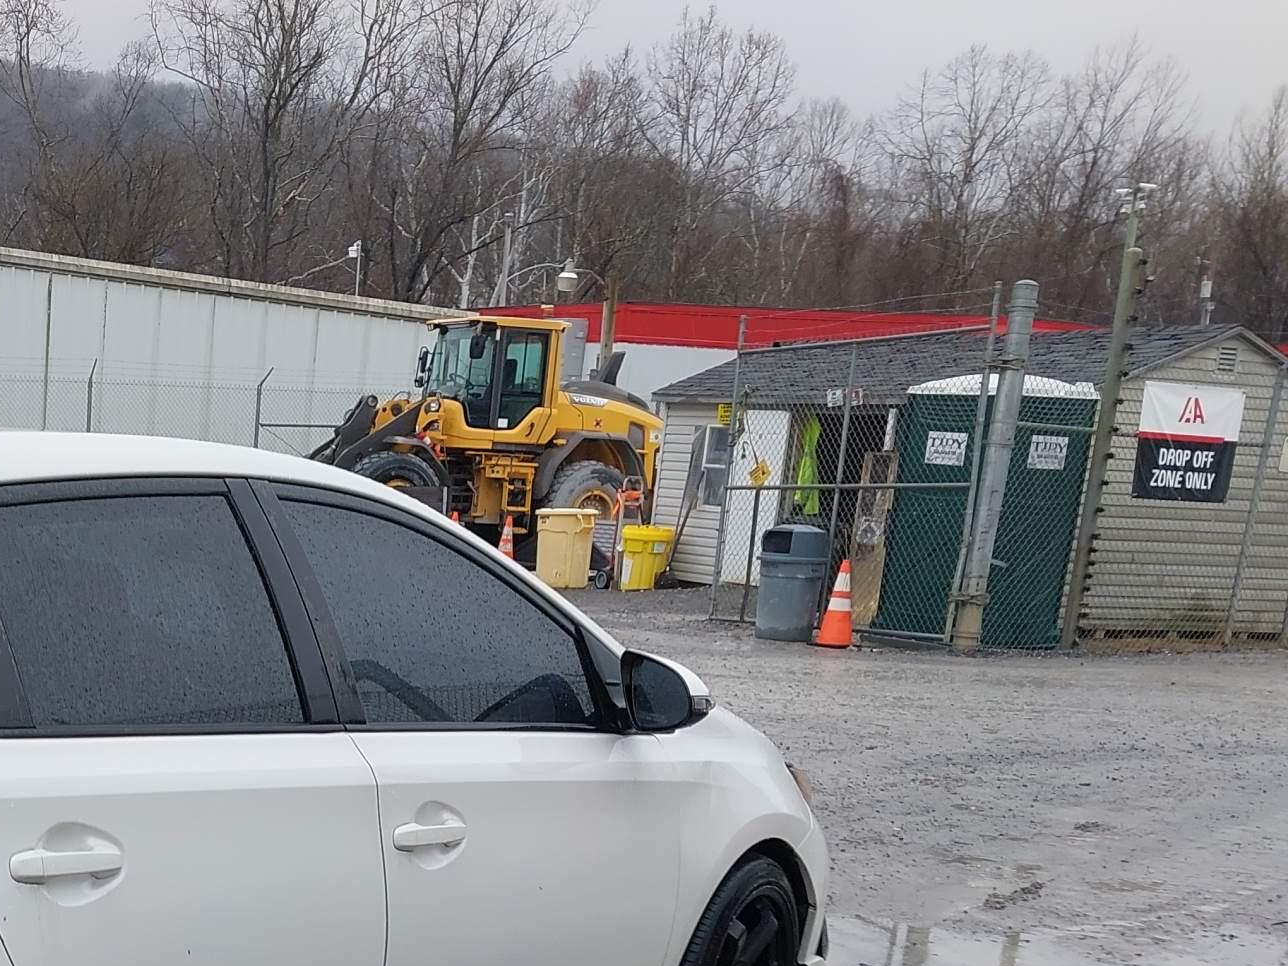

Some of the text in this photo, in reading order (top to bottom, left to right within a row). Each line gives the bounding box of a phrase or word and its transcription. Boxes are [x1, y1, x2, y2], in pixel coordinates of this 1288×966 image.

[929, 437, 966, 449] TIDY
[1032, 441, 1067, 453] TIDY
[1158, 448, 1215, 469] DROP OFF
[1150, 469, 1216, 490] ZONE ONLY
